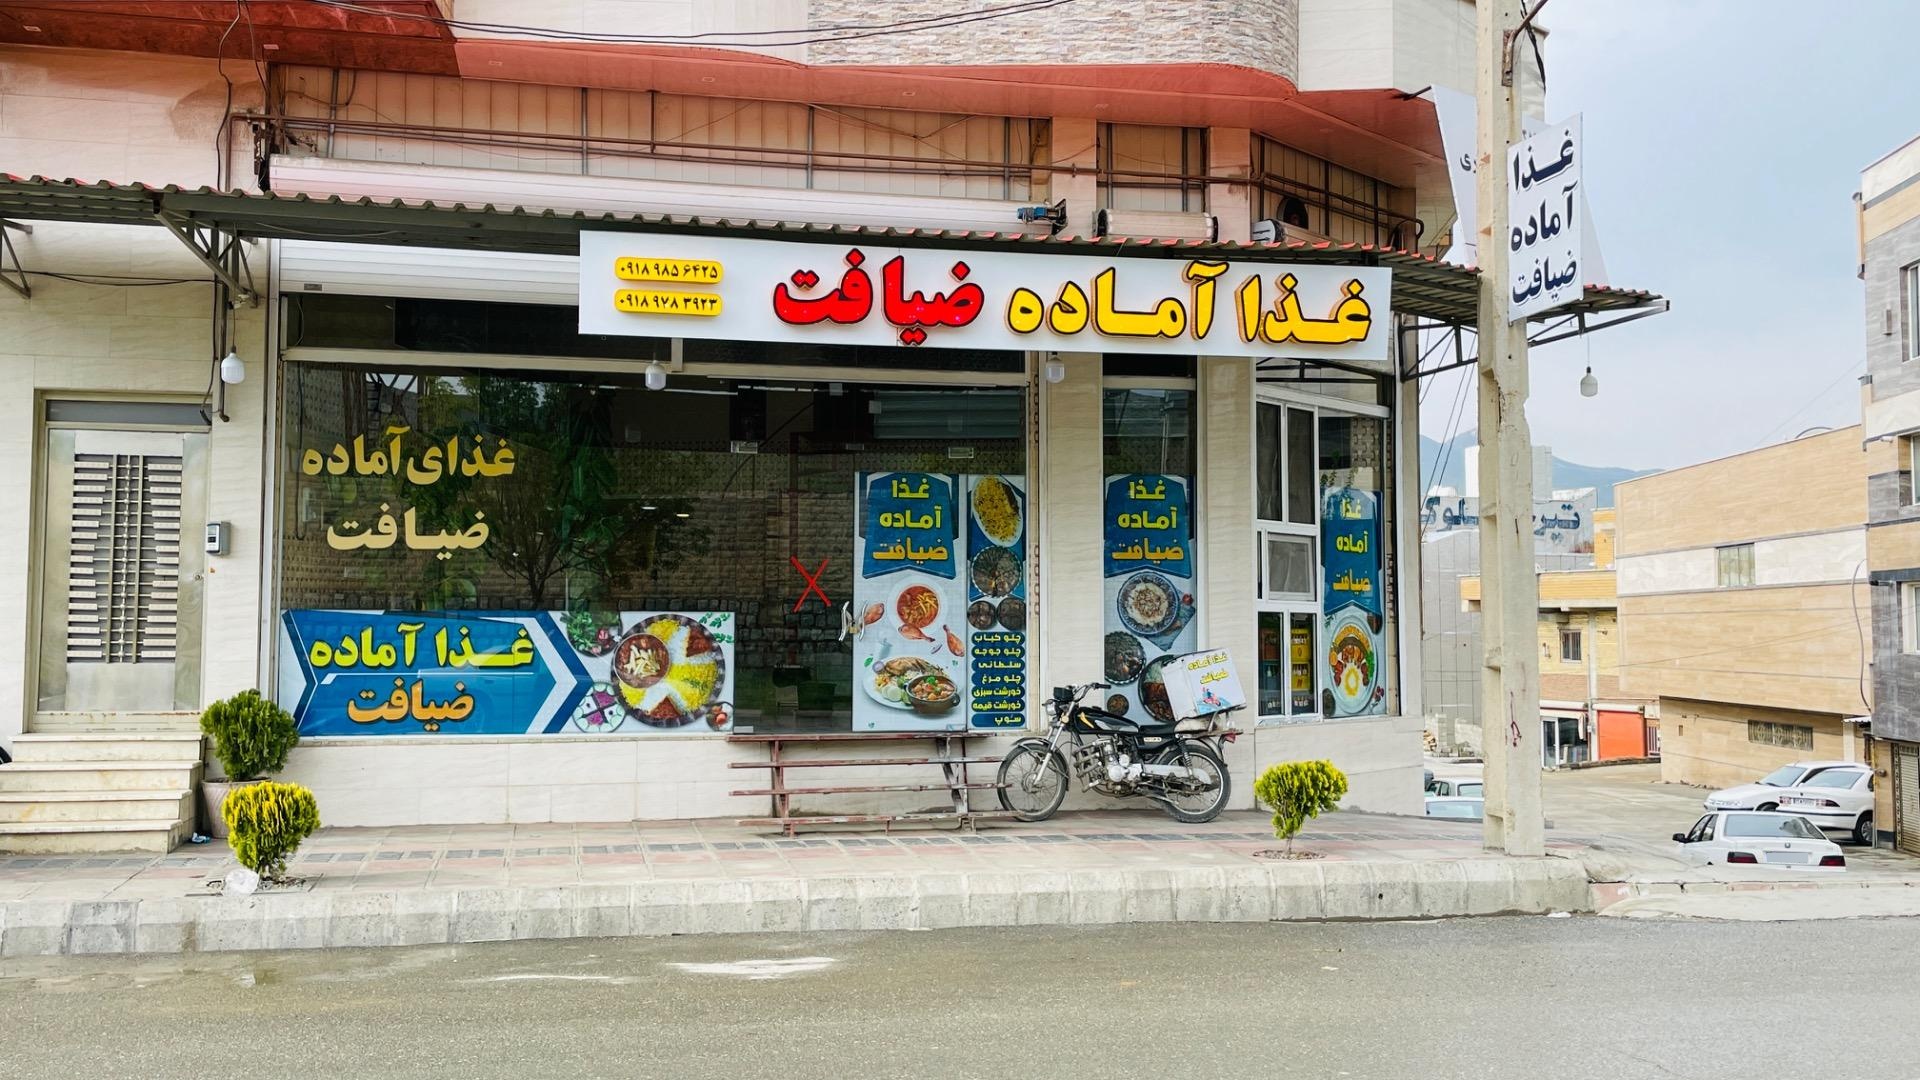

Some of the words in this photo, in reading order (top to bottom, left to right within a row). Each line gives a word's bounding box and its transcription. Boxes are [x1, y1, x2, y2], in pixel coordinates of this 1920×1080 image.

[1513, 129, 1575, 191] غذا
[1511, 180, 1578, 252] آماده
[621, 262, 650, 275] ۰۹۱۸
[654, 263, 679, 277] ۹۸۵
[1512, 250, 1577, 304] ضیافت
[619, 294, 648, 307] ۰۹۱۸
[653, 295, 678, 309] ۹۷۸
[773, 248, 985, 346] ضیافت
[1008, 261, 1230, 341] آماده
[1236, 272, 1372, 346] غذا
[302, 426, 410, 476] آماده
[407, 434, 515, 485] غذای
[891, 478, 930, 499] غذا
[1128, 480, 1166, 501] غذا
[879, 505, 942, 529] آماده
[1117, 505, 1177, 529] آماده
[1340, 498, 1362, 519] غذا
[326, 502, 490, 561] ضیافت
[1336, 530, 1368, 554] آماده
[872, 537, 949, 566] ضیافت
[1111, 538, 1184, 564] ضیافت
[1332, 568, 1372, 593] ضیافت
[309, 622, 424, 669] آماده
[435, 621, 534, 669] غذا
[974, 633, 1001, 643] کباب
[1003, 634, 1021, 644] چلو
[974, 647, 1001, 657] جوجه
[1003, 647, 1021, 658] چلو
[978, 661, 1021, 669] سلطانی
[1200, 668, 1229, 684] ضیافت
[981, 673, 1001, 685] مرغ
[1003, 674, 1021, 685] چلو
[346, 678, 474, 732] ضیافت
